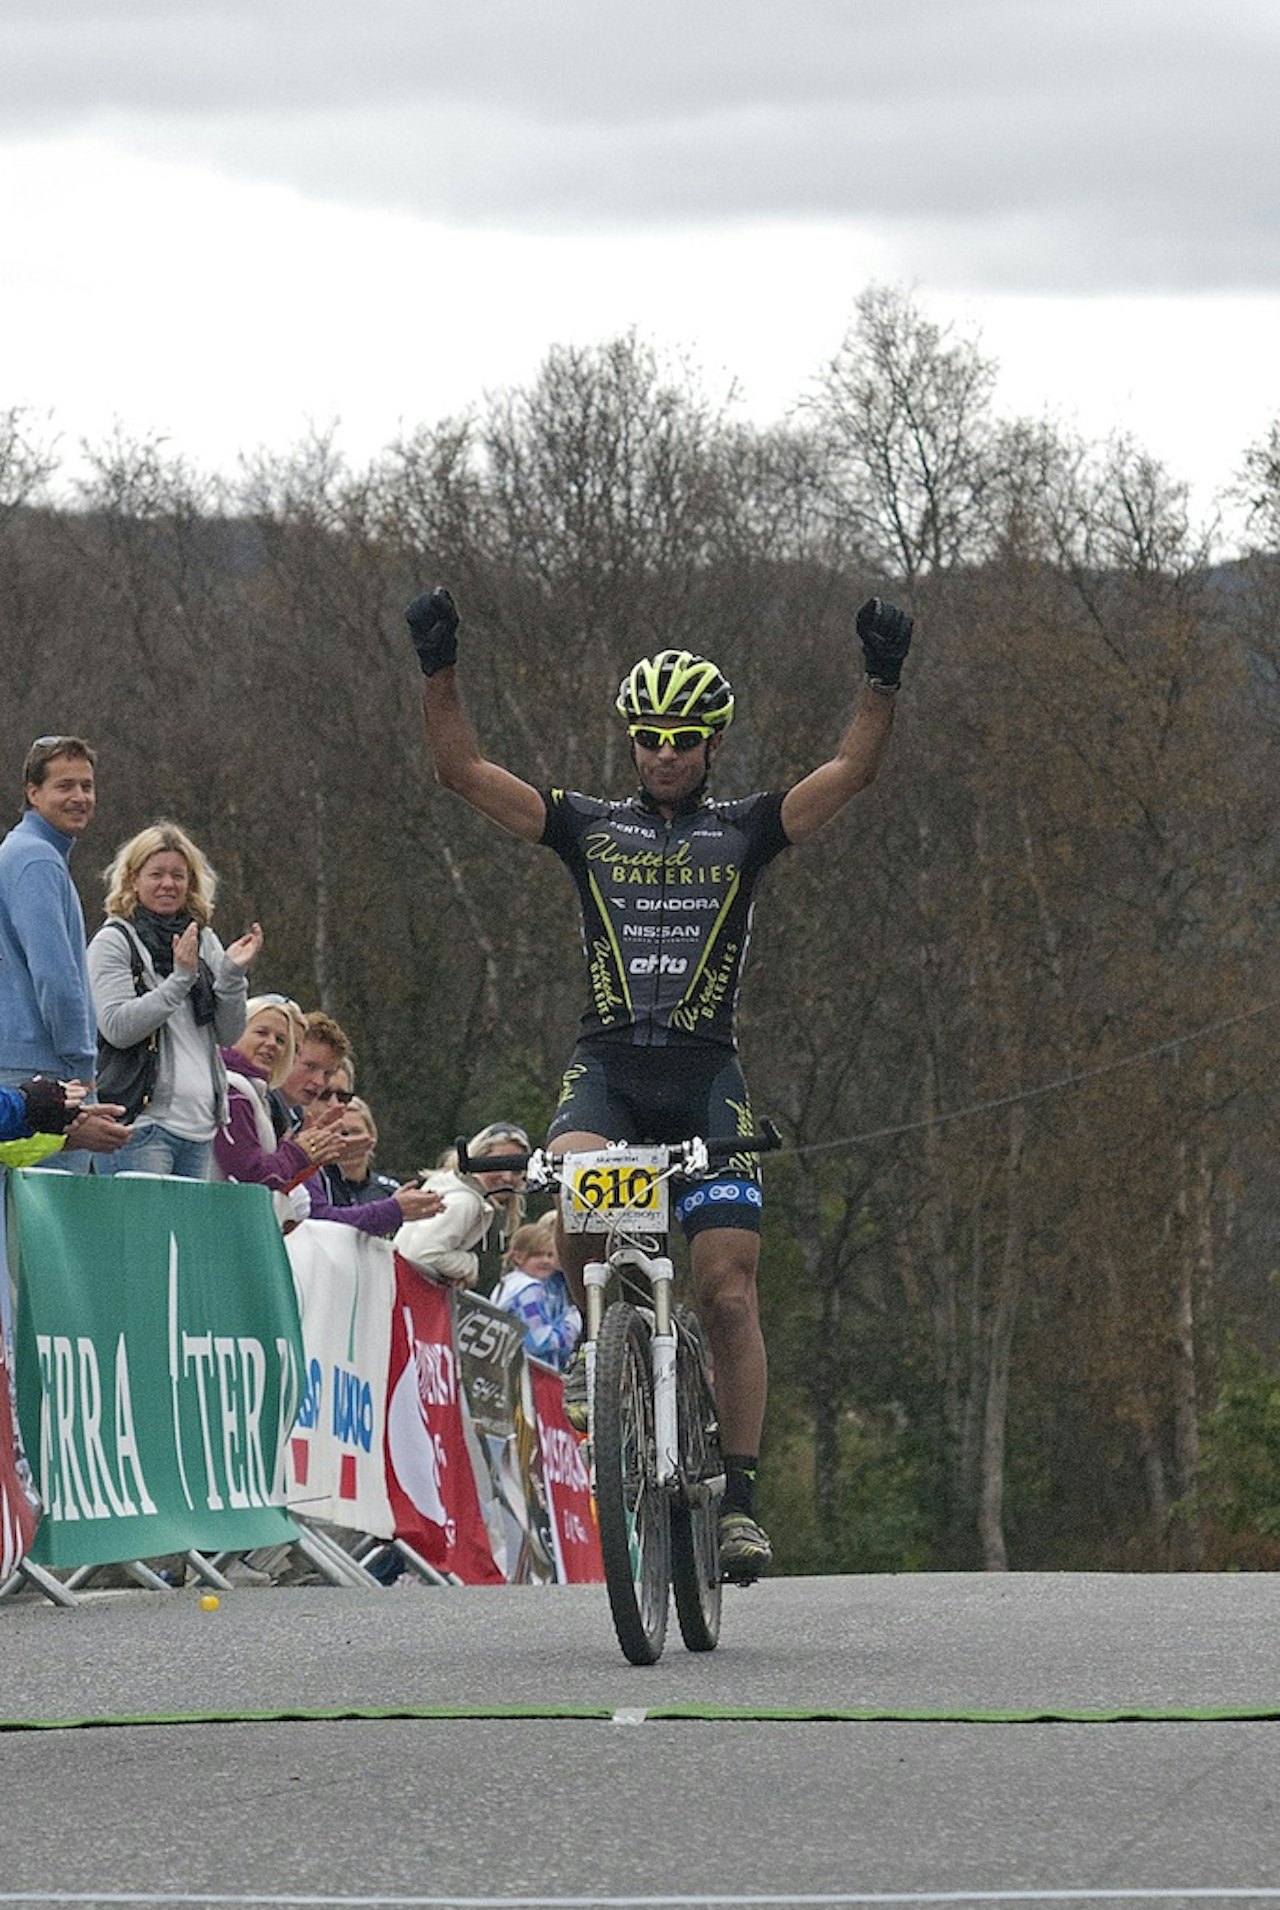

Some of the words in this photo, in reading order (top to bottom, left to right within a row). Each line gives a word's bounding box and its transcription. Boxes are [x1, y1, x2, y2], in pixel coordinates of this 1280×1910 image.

[586, 833, 693, 866] United
[612, 864, 736, 885] BAKERIES
[636, 899, 721, 910] DIADORA
[623, 924, 700, 937] NISSAN
[579, 1169, 653, 1209] 610
